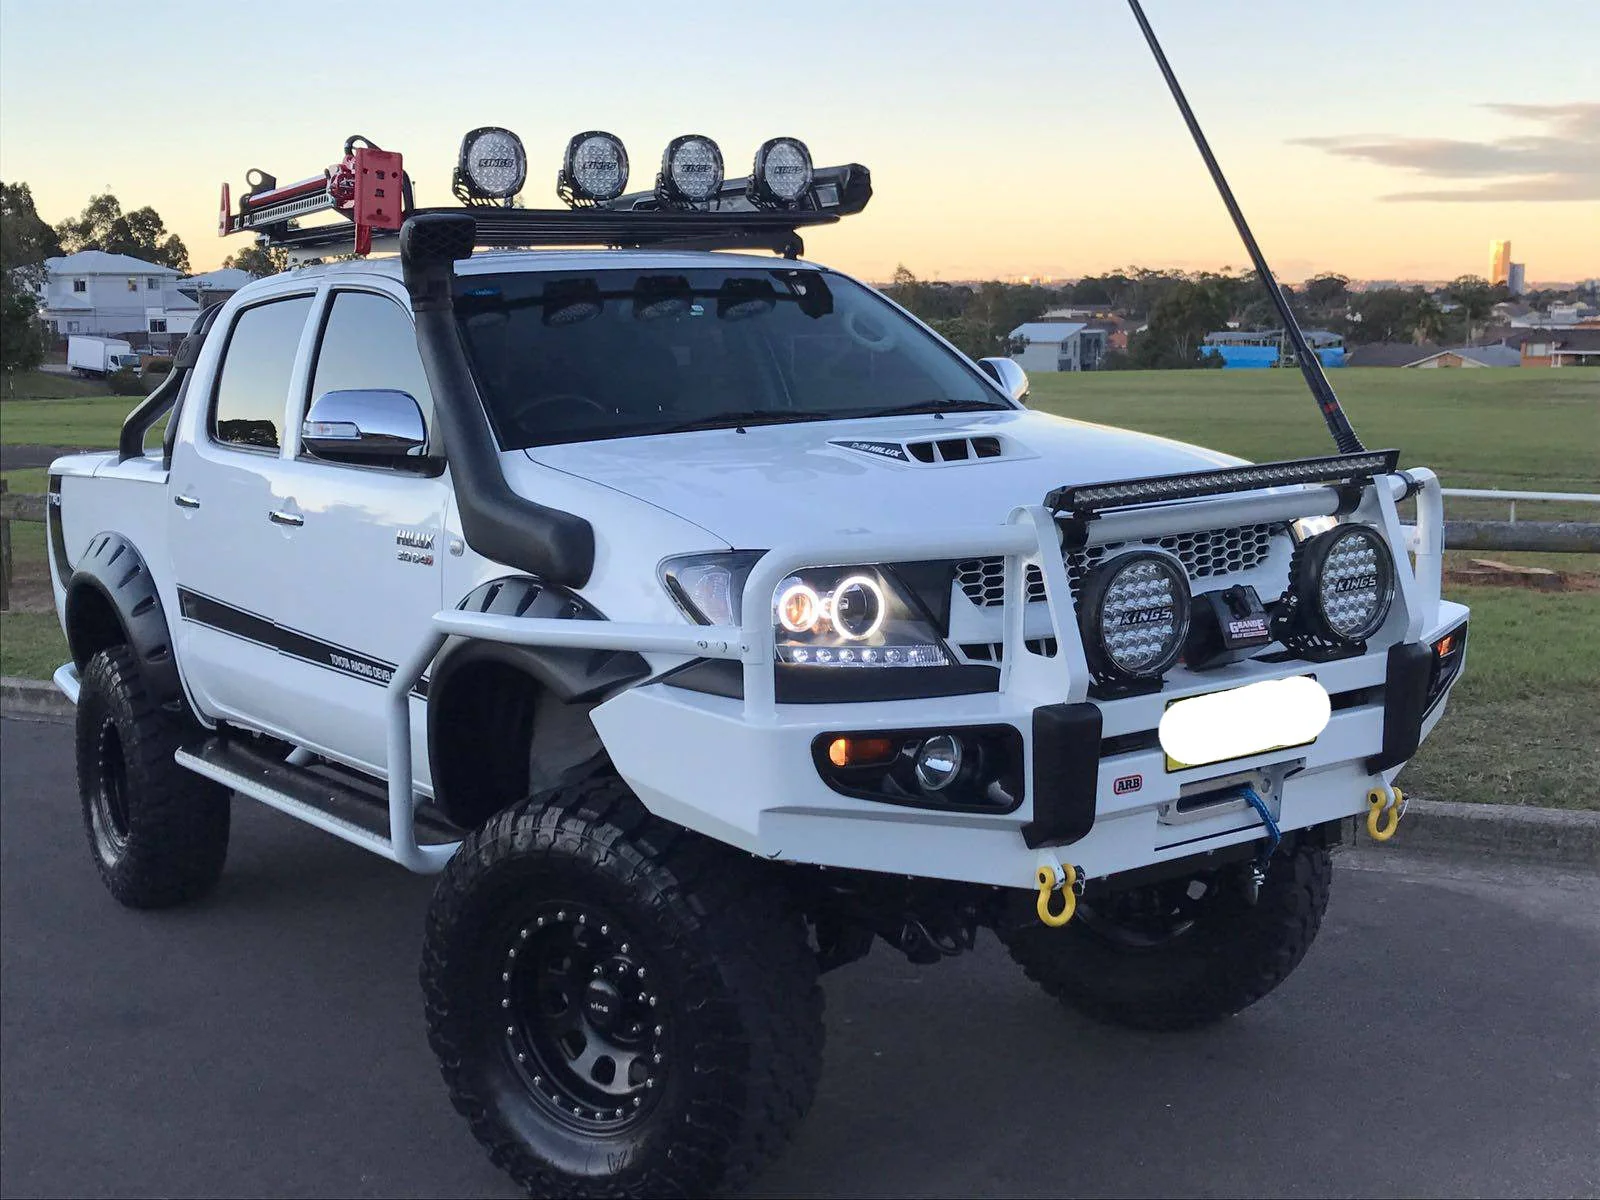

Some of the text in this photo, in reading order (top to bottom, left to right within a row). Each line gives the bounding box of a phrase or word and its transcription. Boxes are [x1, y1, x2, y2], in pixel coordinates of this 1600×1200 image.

[396, 530, 435, 550] HILUX
[1336, 574, 1378, 593] KINGS
[1120, 606, 1172, 626] KINGS
[330, 653, 350, 669] TOYOTA
[350, 660, 372, 676] RACING
[1117, 778, 1140, 792] ARB
